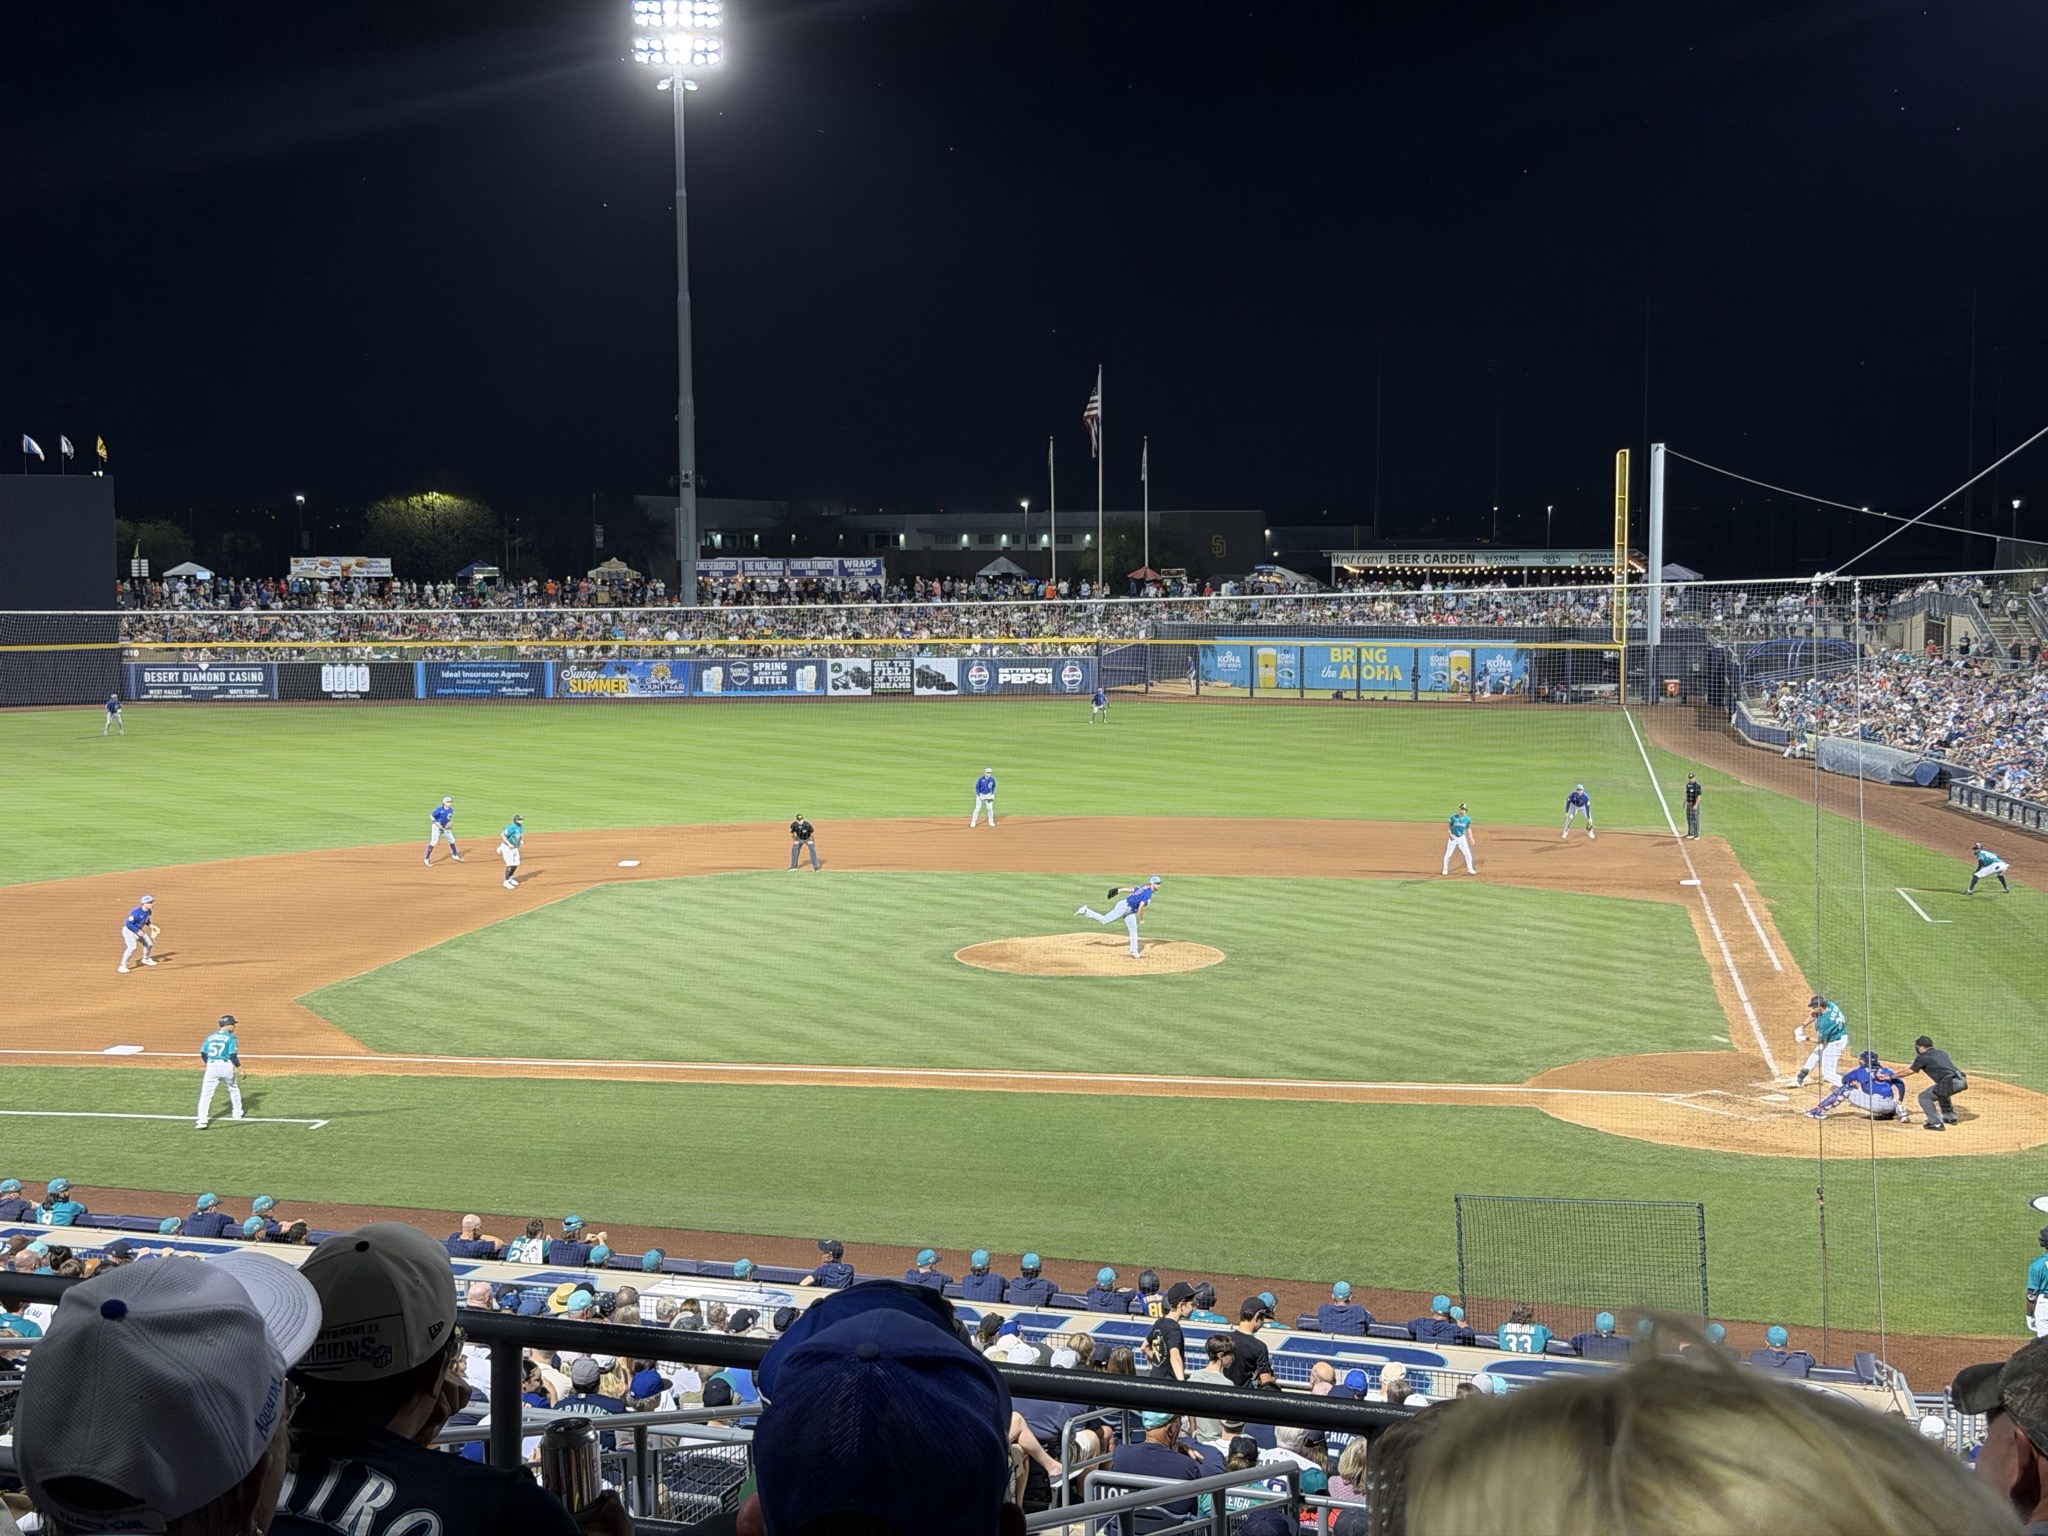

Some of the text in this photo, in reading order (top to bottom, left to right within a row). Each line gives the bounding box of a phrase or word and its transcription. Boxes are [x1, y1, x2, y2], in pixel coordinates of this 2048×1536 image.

[843, 560, 877, 568] WRAPS
[1331, 554, 1355, 564] West
[1388, 554, 1420, 564] BEER
[1423, 554, 1476, 564] GARDEN
[1330, 647, 1387, 663] BRNG
[753, 662, 788, 671] SPRING
[1486, 660, 1512, 668] KONA
[144, 671, 264, 682] DESERT DIAMOND CASINO
[500, 671, 530, 679] Agency
[561, 665, 598, 683] Swing
[873, 667, 911, 676] FIELD
[1321, 665, 1337, 678] the
[753, 676, 788, 684] BETTER
[998, 673, 1053, 684] PEPSI
[569, 679, 628, 693] SUMMER
[208, 1042, 225, 1057] 57
[1505, 1334, 1532, 1352] 33
[306, 1337, 376, 1362] PIONS
[1225, 1495, 1251, 1510] EIGH
